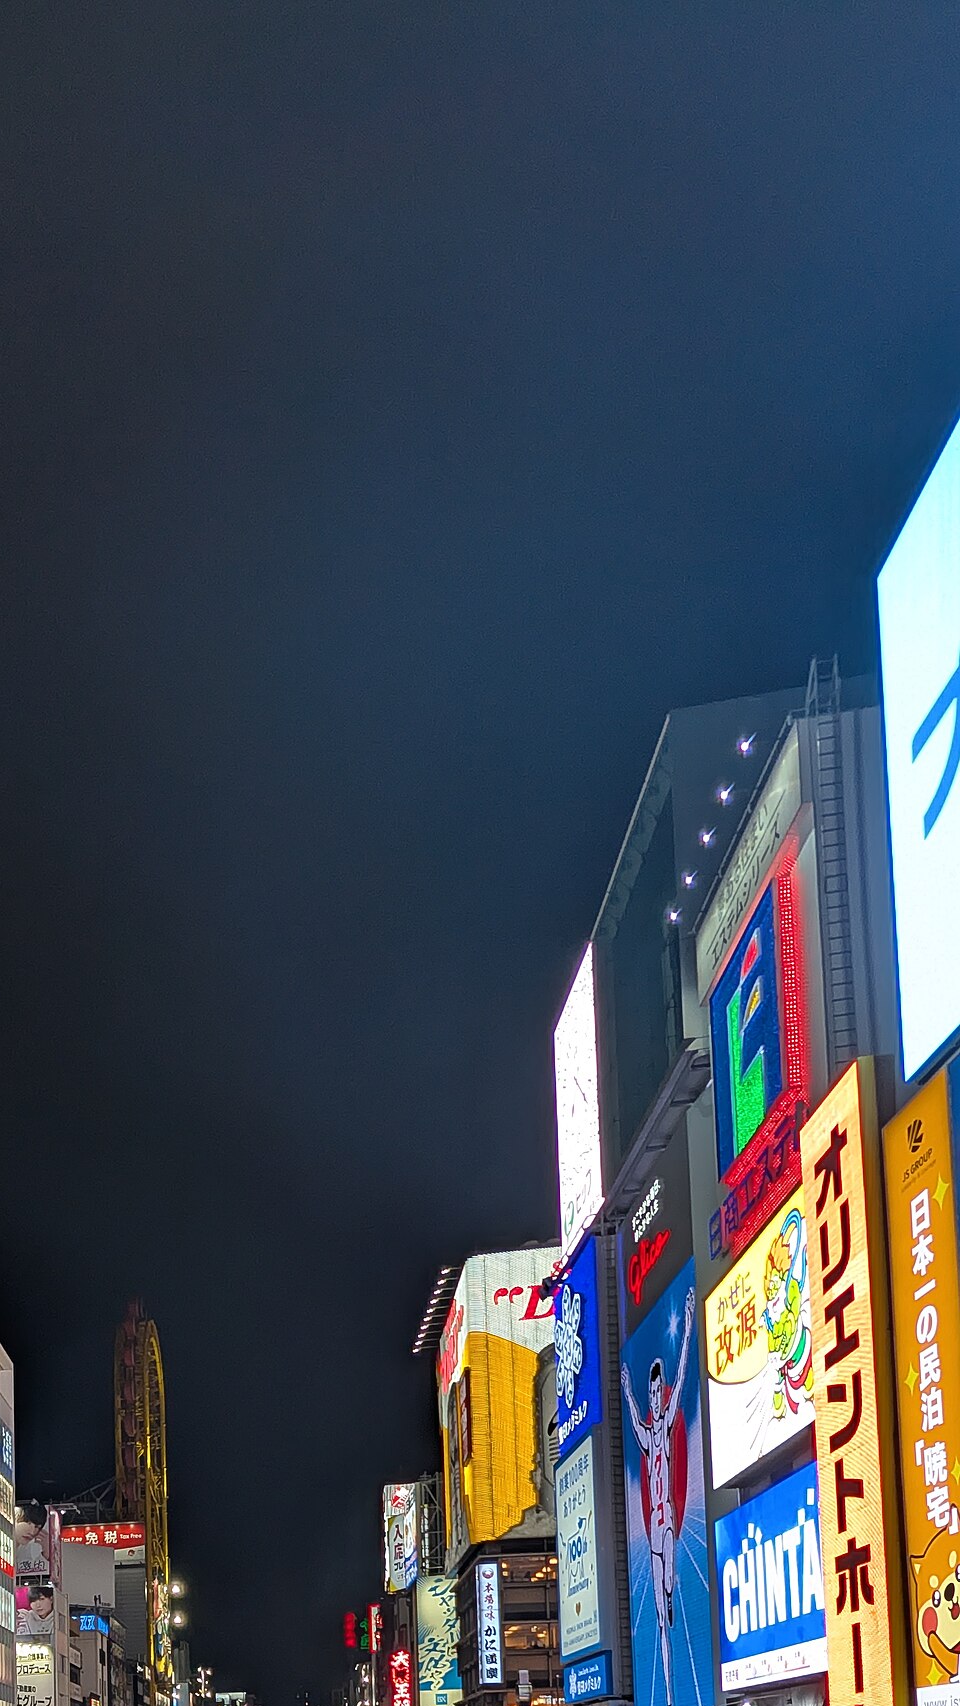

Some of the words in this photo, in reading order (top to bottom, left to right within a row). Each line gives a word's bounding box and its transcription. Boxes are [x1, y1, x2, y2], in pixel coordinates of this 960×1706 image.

[902, 1168, 911, 1183] JS
[910, 1148, 933, 1175] GROUP
[630, 1229, 671, 1306] Glico
[717, 1271, 751, 1325] かぜに
[715, 1294, 758, 1376] 改源
[653, 1451, 665, 1527] グリコ
[85, 1530, 117, 1545] 免税
[722, 1516, 825, 1643] CHINTA
